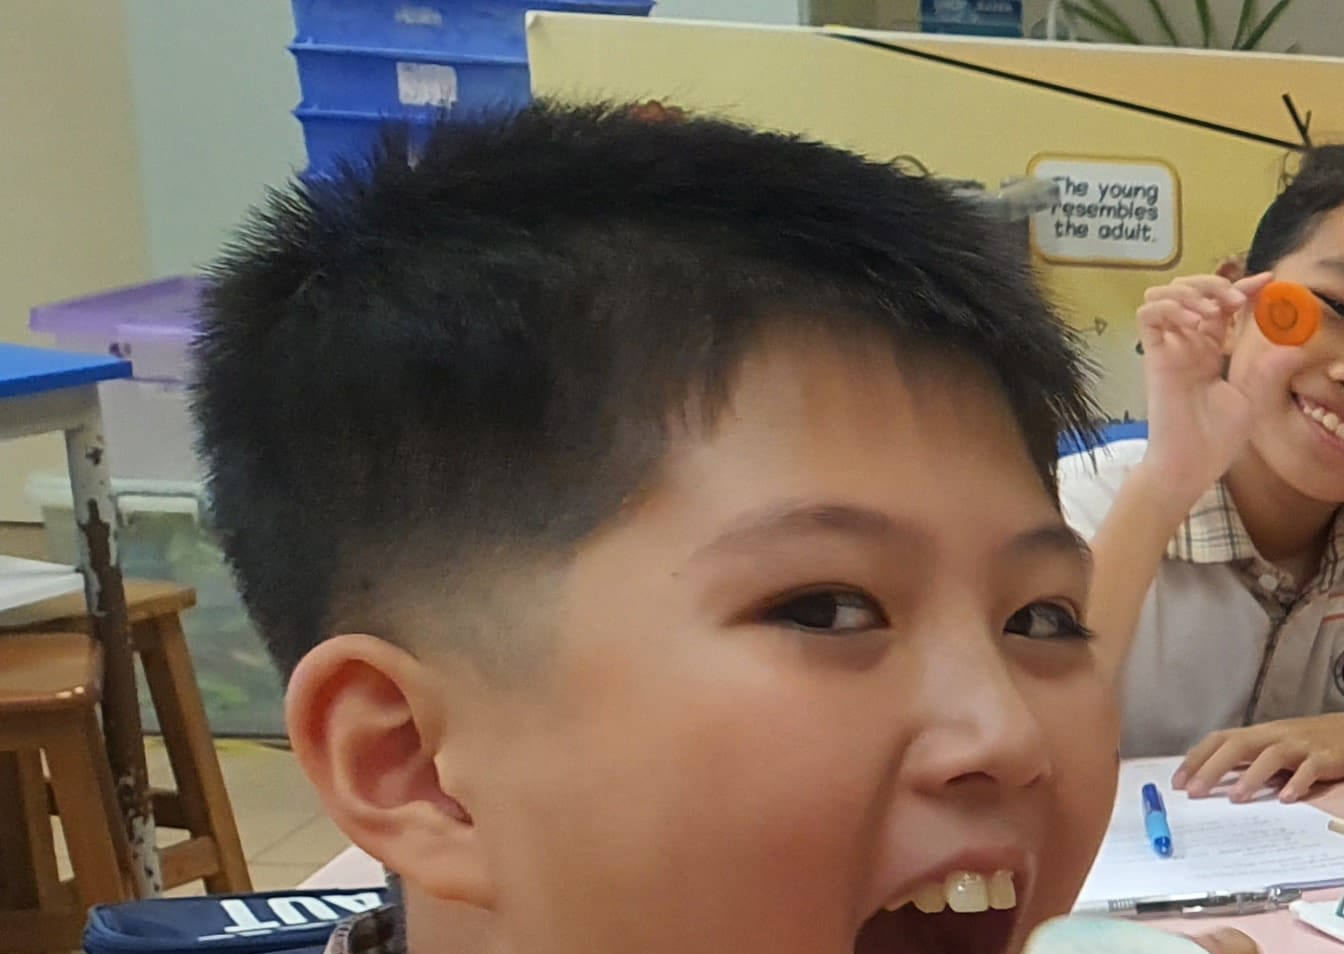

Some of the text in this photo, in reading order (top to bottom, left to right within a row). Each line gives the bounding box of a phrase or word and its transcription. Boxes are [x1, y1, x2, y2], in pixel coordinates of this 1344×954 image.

[1052, 176, 1158, 204] The young
[1051, 202, 1158, 221] resembles
[1055, 219, 1089, 238] the
